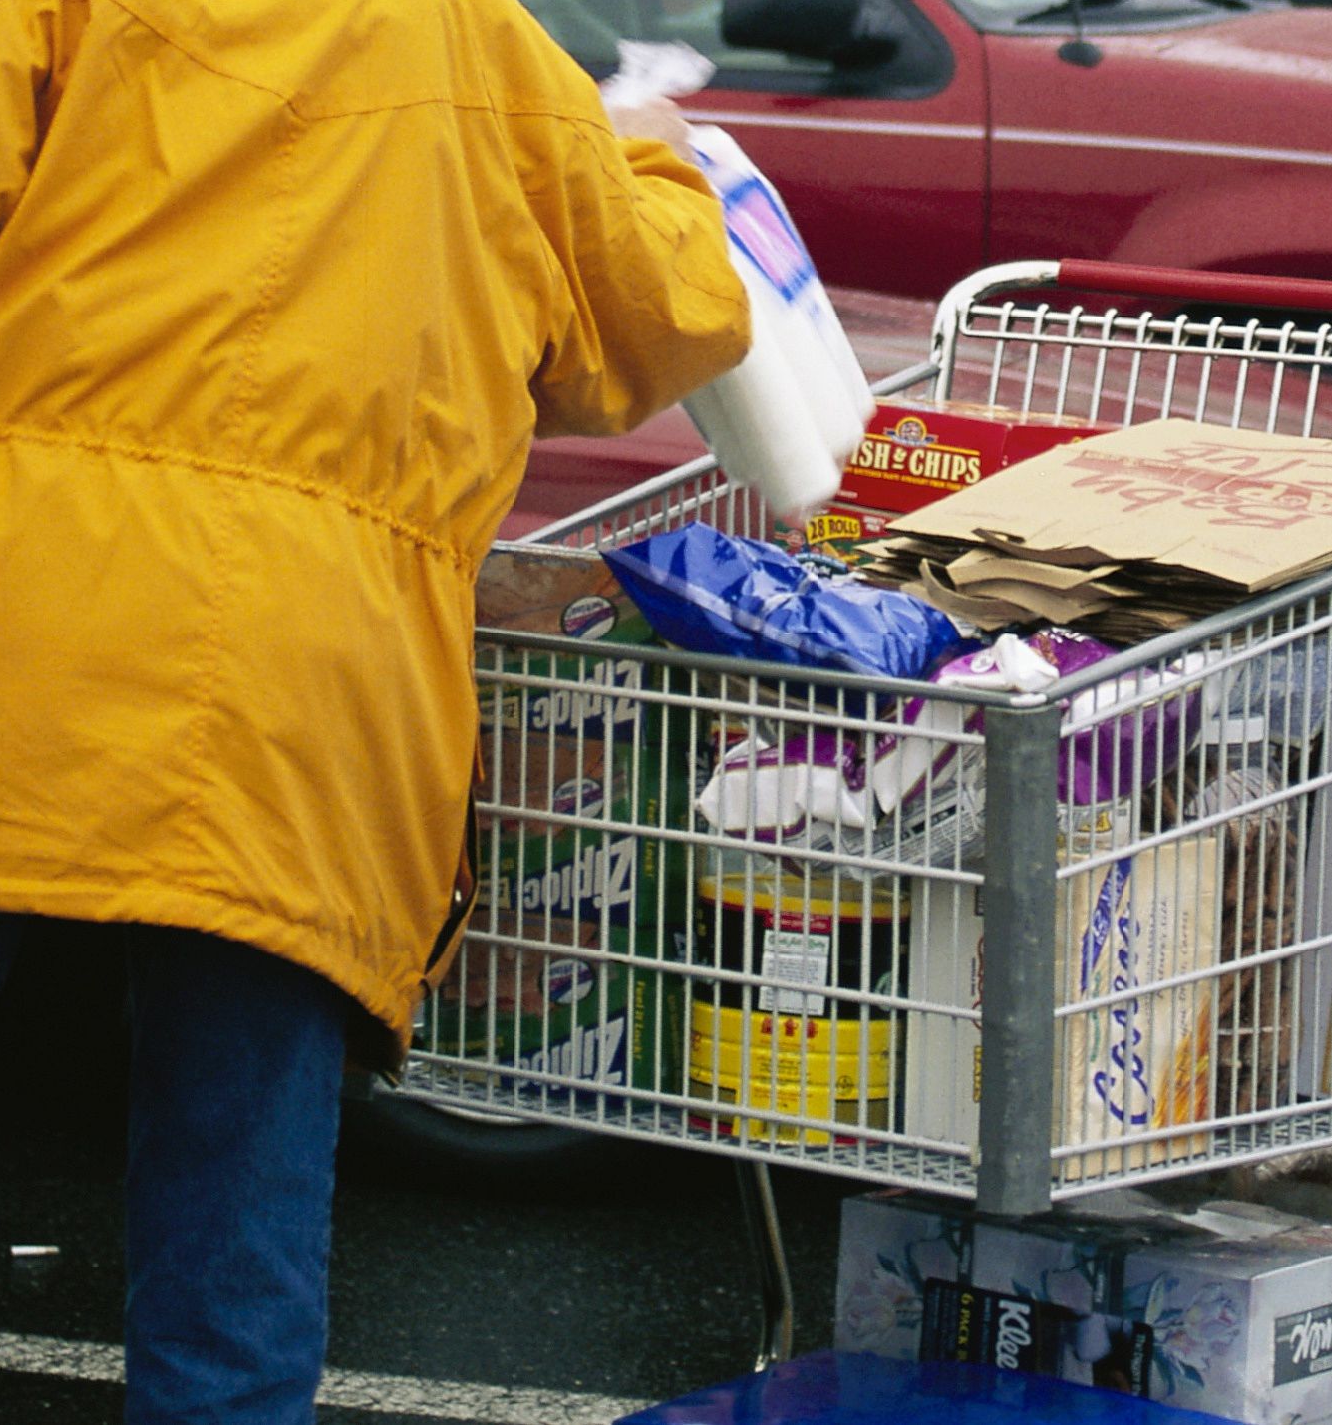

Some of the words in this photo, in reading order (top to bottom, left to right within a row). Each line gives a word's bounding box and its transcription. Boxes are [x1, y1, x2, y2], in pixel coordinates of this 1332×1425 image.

[850, 441, 890, 470] ISH
[893, 448, 906, 470] &
[909, 449, 980, 485] CHIPS
[1072, 475, 1313, 530] Baby
[810, 519, 825, 539] 28
[828, 519, 858, 536] ROLLS
[532, 659, 643, 730] Ziploc
[522, 835, 636, 913] Ziploc
[961, 1292, 975, 1305] 6
[956, 1308, 972, 1345] PACK
[996, 1298, 1032, 1368] Klee
